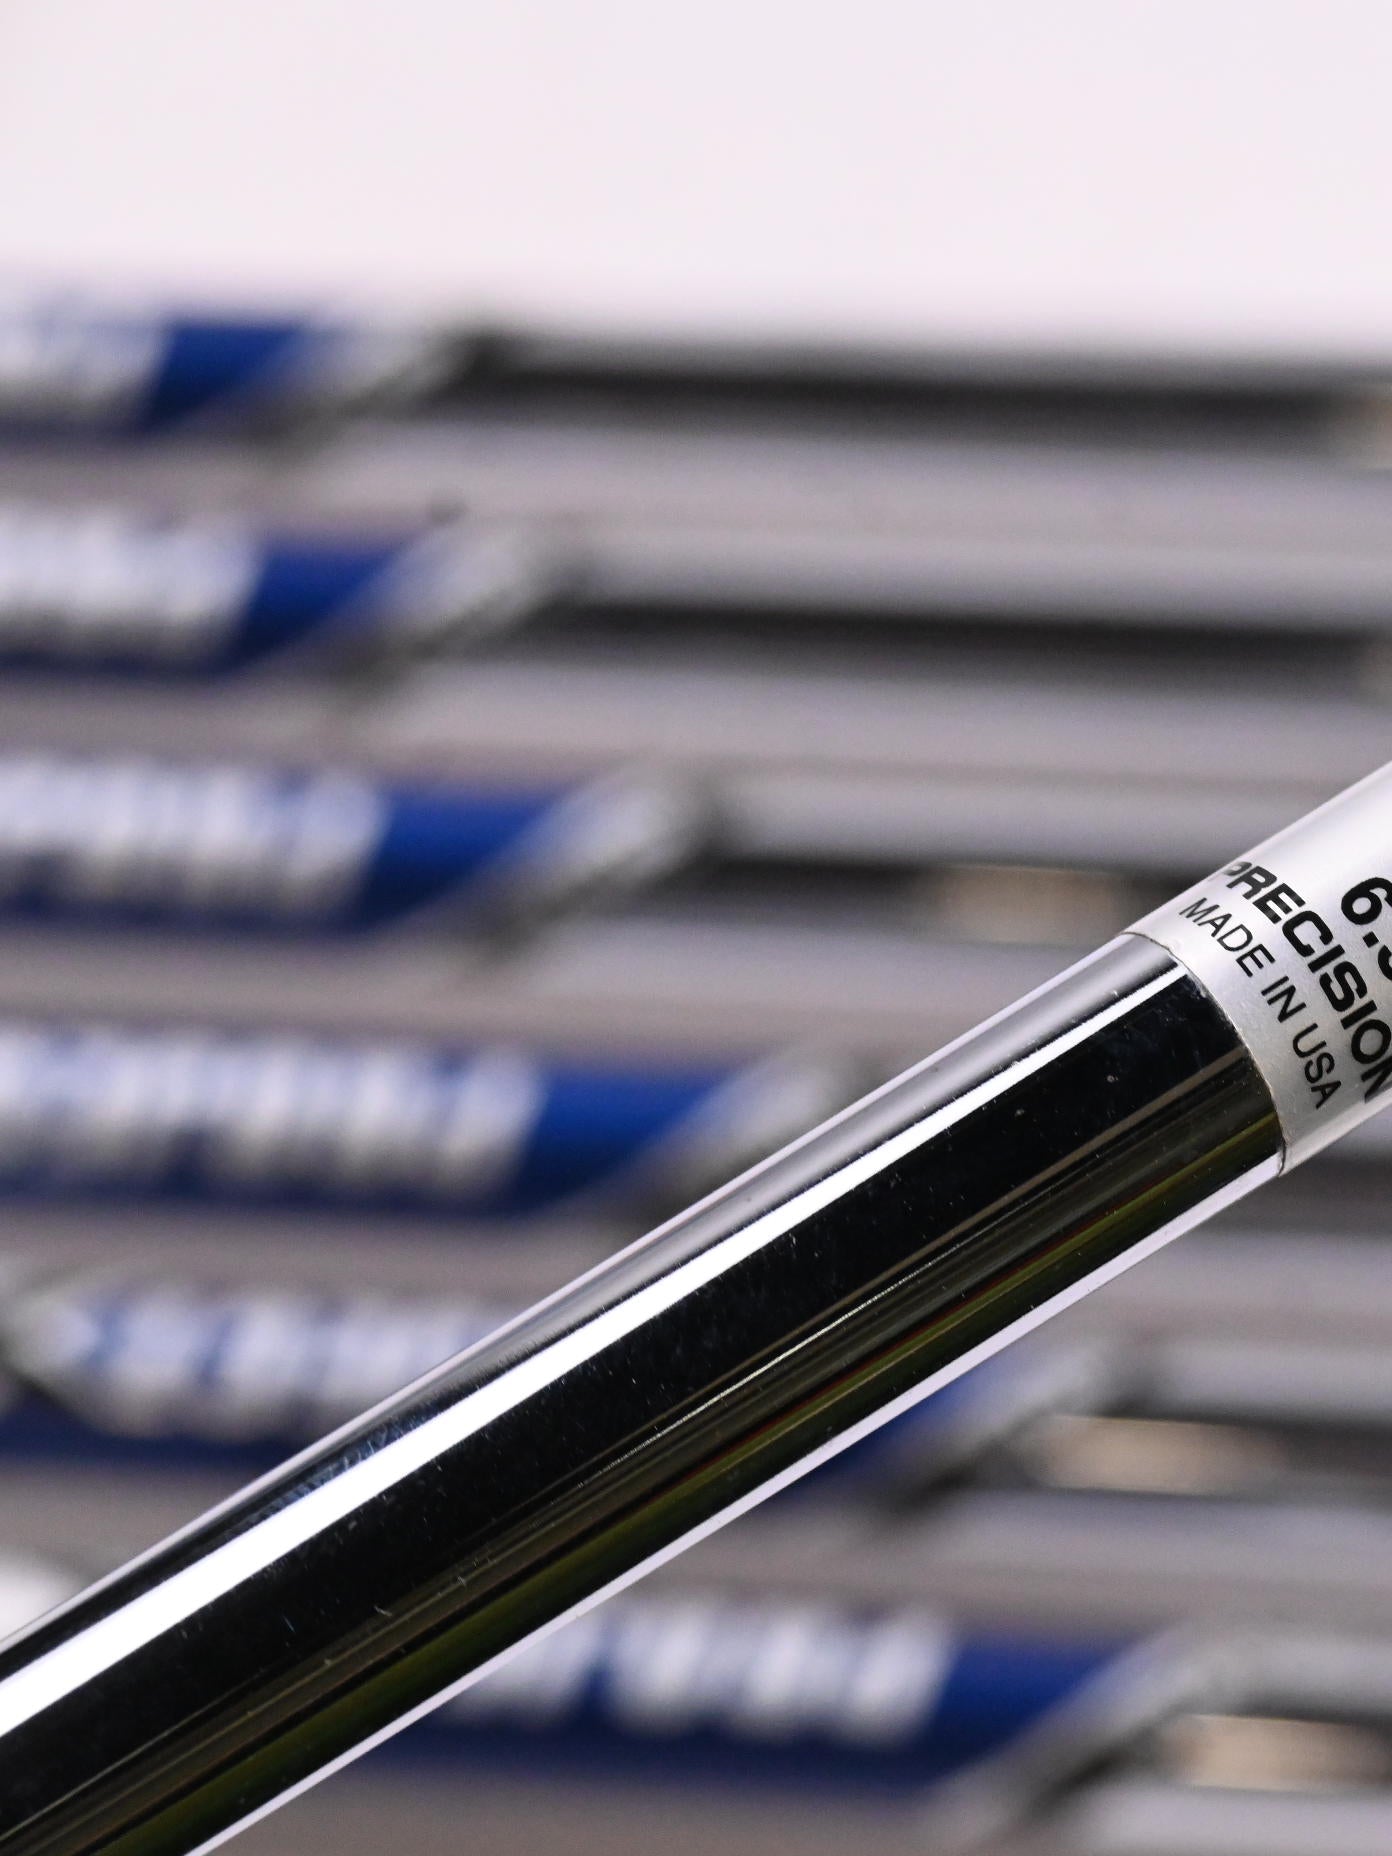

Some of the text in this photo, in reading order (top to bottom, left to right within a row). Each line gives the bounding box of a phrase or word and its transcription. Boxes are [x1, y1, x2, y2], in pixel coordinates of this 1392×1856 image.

[1179, 897, 1342, 1110] MADE IN USA
